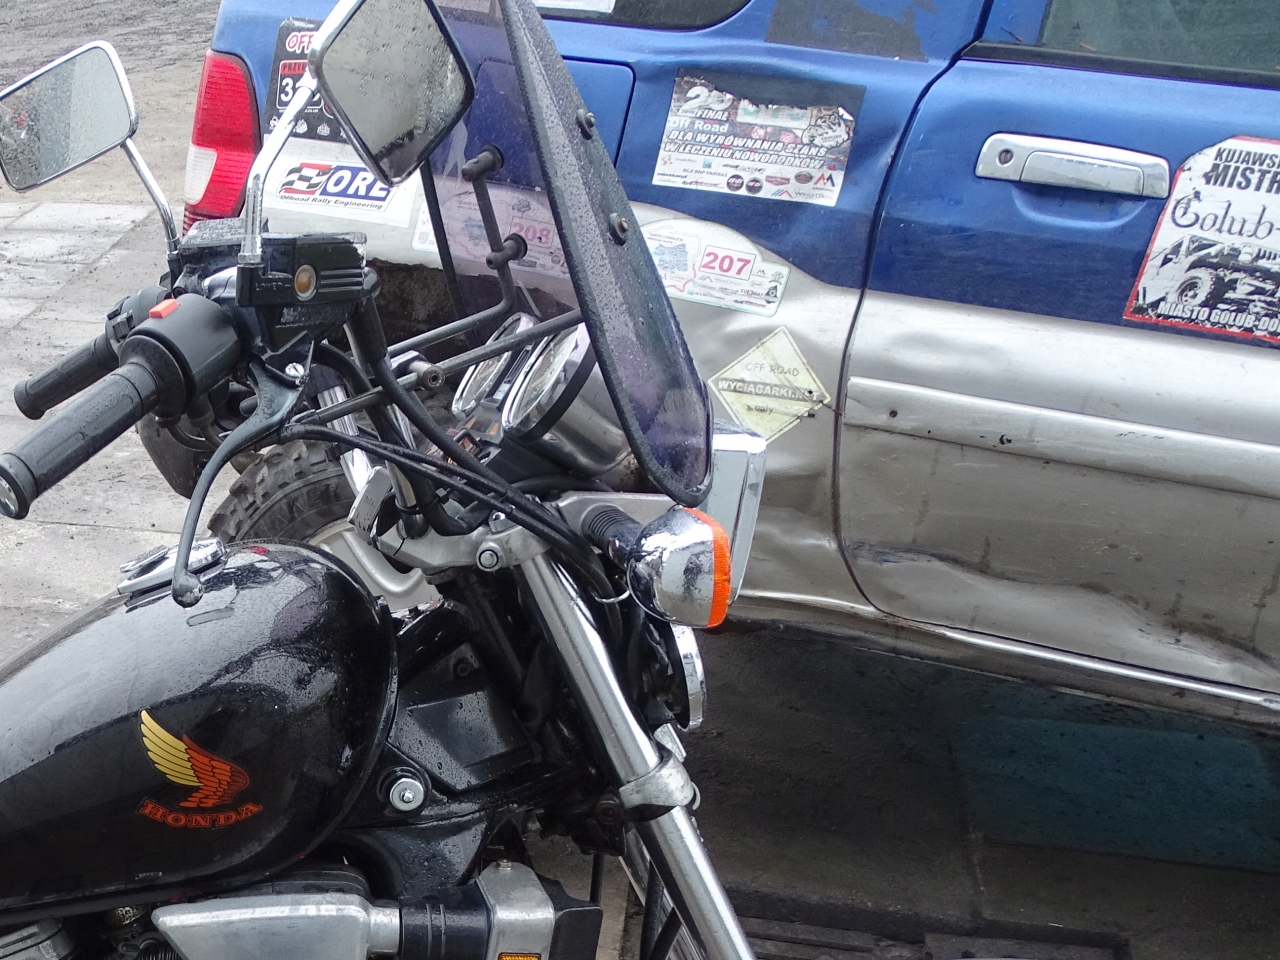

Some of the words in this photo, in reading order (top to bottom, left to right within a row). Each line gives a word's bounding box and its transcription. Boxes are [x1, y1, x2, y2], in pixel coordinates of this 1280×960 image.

[668, 117, 691, 129] Off
[694, 120, 729, 133] Road
[664, 142, 680, 152] W
[678, 143, 733, 159] LECZENIU
[668, 130, 694, 141] DLA
[695, 132, 785, 150] WYRÓWNANIA
[785, 143, 828, 157] SZANS
[280, 195, 310, 203] Offroad
[334, 199, 383, 210] Engineering
[701, 251, 752, 276] 207
[1157, 301, 1210, 320] MIASTO
[745, 362, 766, 373] OFF
[770, 364, 800, 377] ROAD
[138, 798, 264, 828] HONDA
